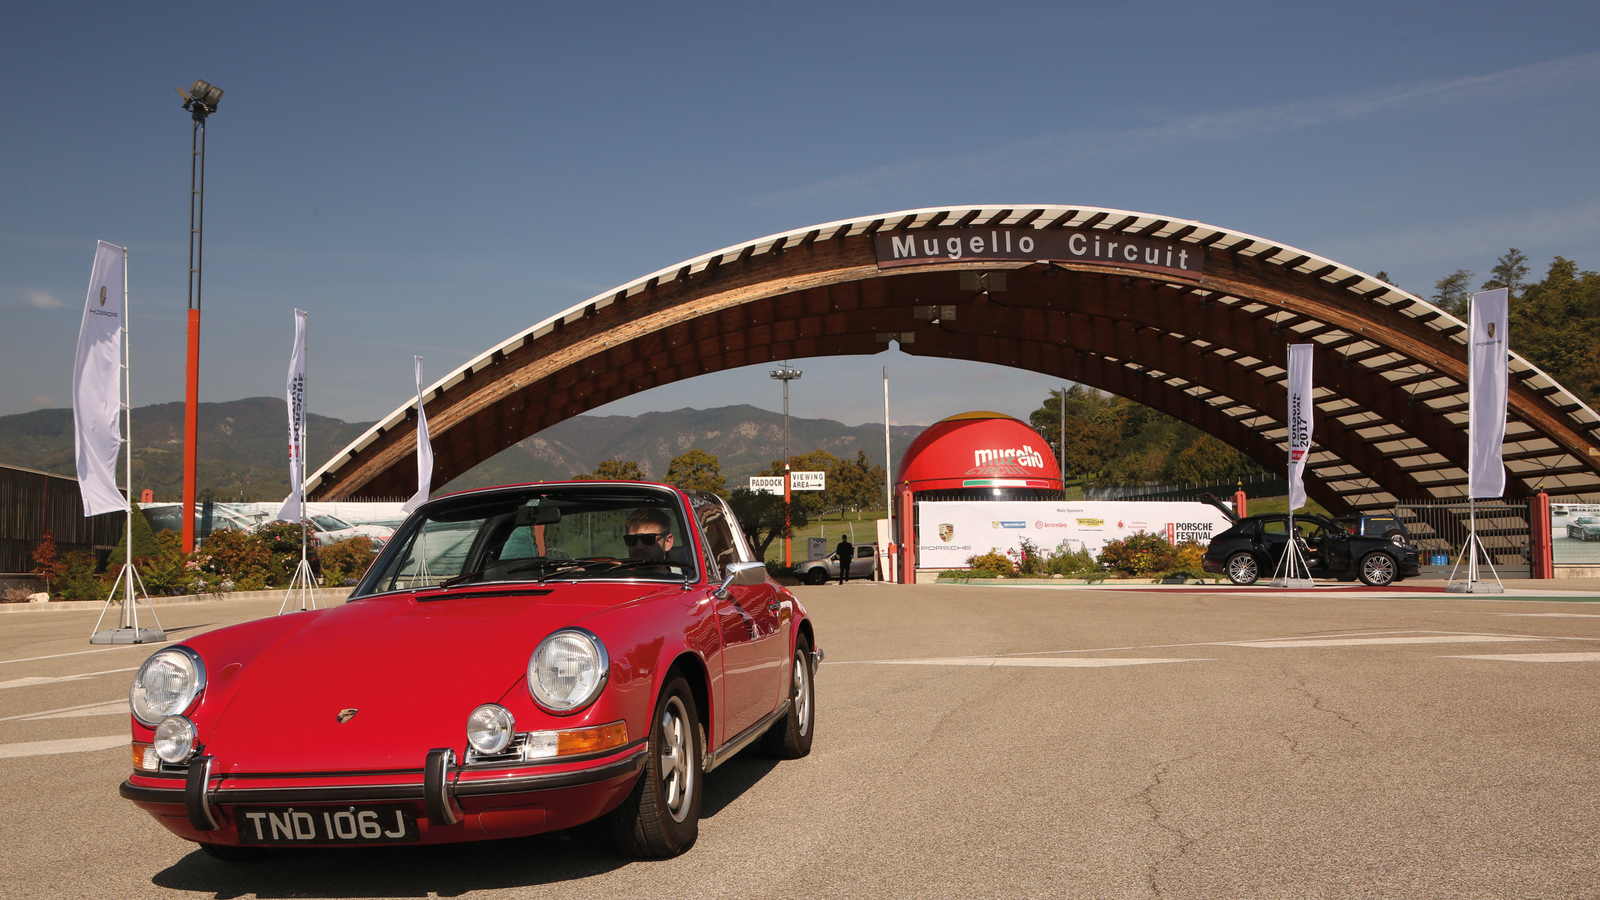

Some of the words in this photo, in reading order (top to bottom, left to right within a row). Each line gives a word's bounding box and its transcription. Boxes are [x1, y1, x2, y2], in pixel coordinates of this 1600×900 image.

[892, 230, 1035, 260] Mugello
[1068, 233, 1189, 270] Circuit
[1475, 339, 1502, 347] PORSCHE
[1299, 417, 1309, 448] 2017
[974, 445, 1044, 469] mugello
[965, 466, 1032, 475] CIRCUIT
[751, 479, 783, 487] PADDOCK
[1175, 522, 1214, 531] PORSCHE
[1176, 531, 1212, 540] FESTIVAL
[245, 811, 316, 841] TND
[323, 809, 406, 840] 106J
